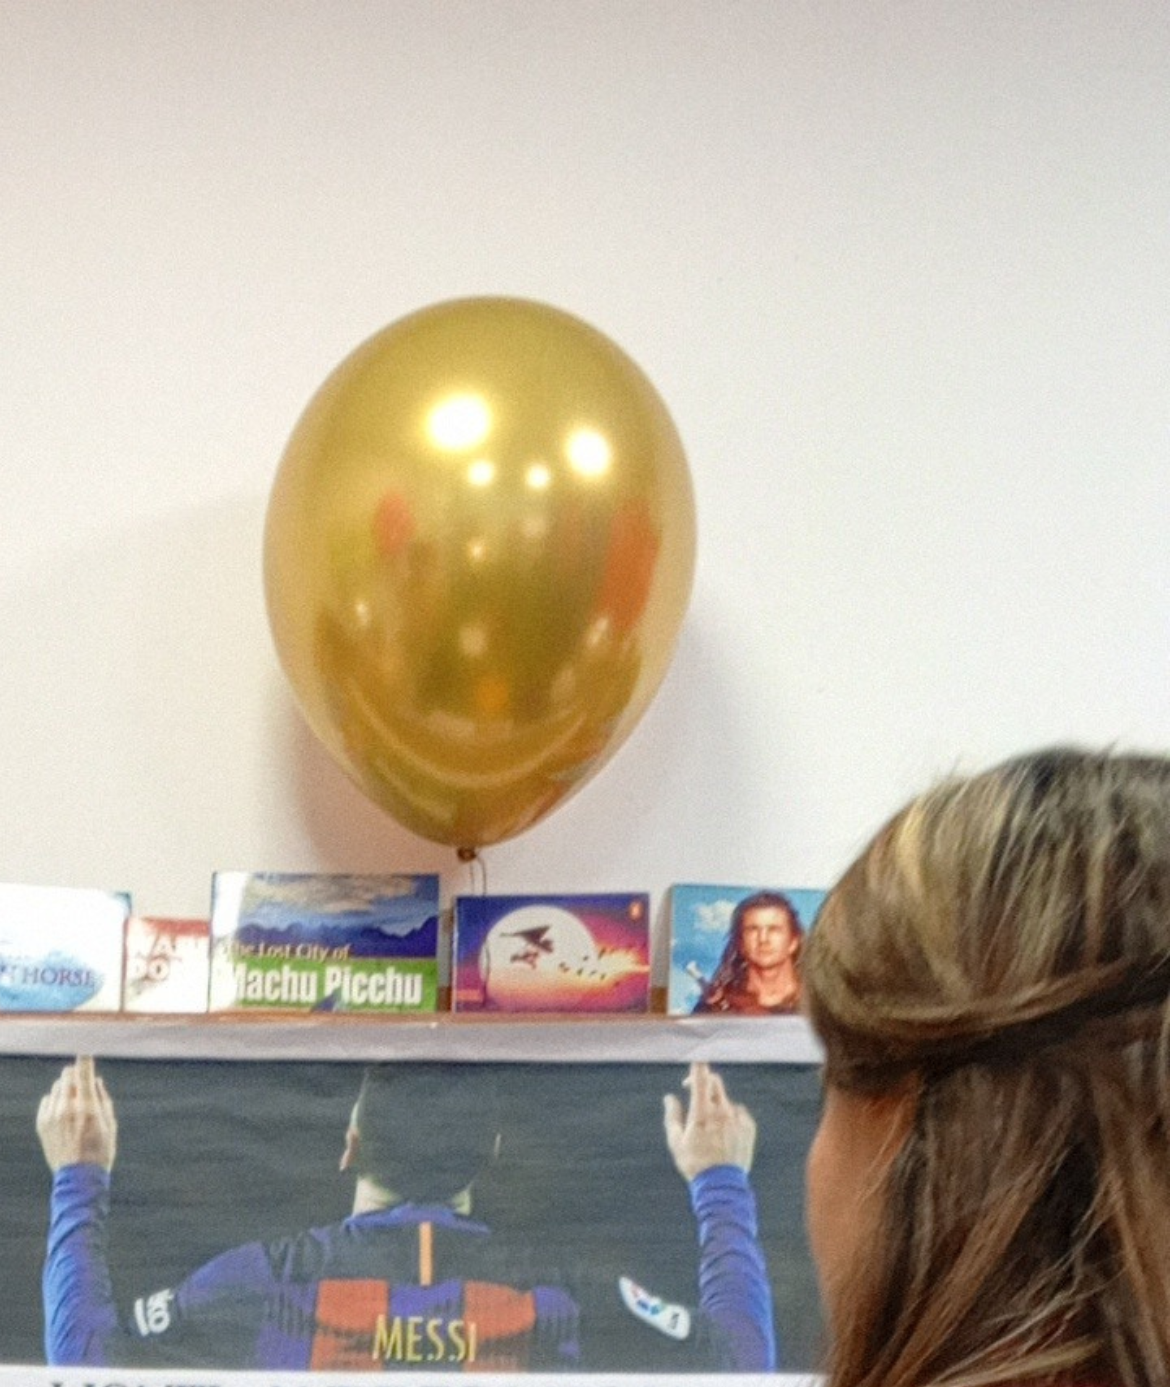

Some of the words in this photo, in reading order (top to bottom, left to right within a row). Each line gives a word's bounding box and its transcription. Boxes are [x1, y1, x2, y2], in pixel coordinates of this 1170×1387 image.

[257, 942, 290, 959] Lost
[296, 943, 329, 963] City
[333, 943, 351, 960] of
[22, 964, 95, 987] HORSE
[325, 965, 423, 1005] Picchu
[372, 1314, 478, 1363] MESSI
